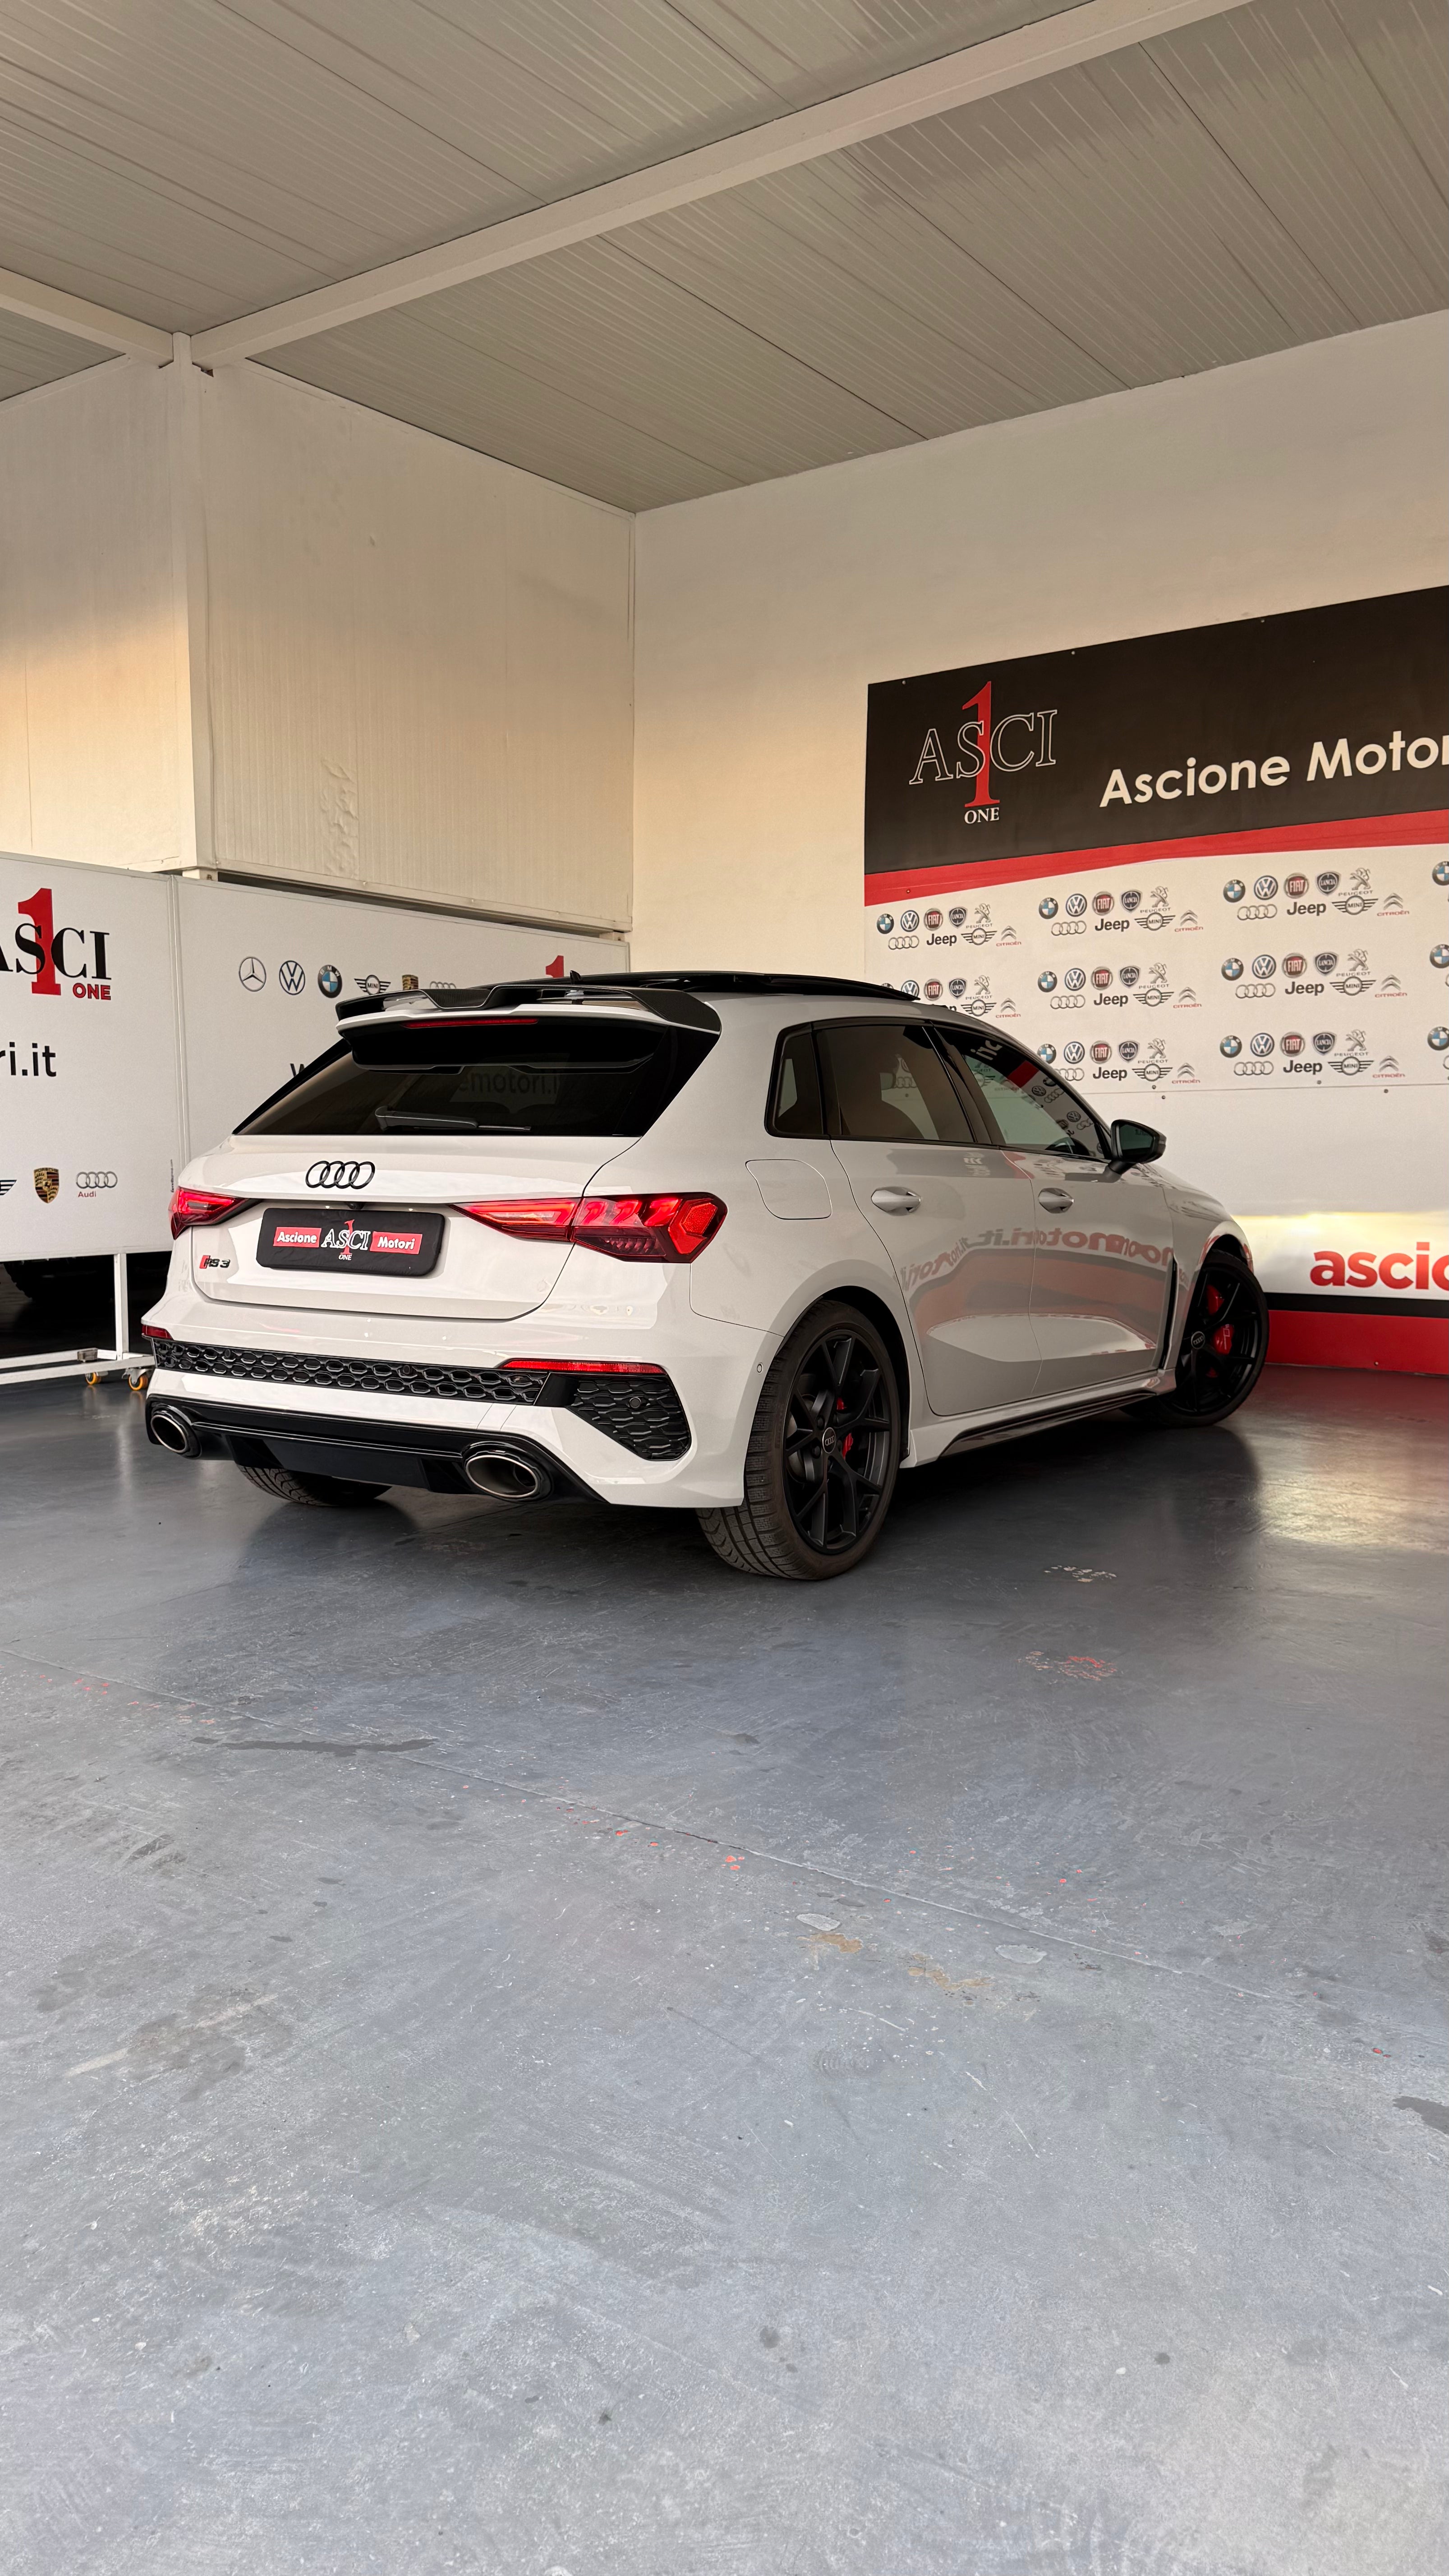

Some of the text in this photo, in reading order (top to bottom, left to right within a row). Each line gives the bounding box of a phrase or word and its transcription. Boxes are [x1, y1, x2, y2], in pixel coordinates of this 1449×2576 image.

[909, 710, 1058, 785] ASCI
[1099, 756, 1290, 808] Ascione
[964, 807, 999, 824] ONE
[1289, 880, 1304, 892] FIAT
[1097, 897, 1110, 909] FIAT
[1287, 902, 1326, 916] Jeep
[928, 915, 939, 925] FIAT
[1095, 918, 1130, 932] Jeep
[926, 934, 957, 946] Jeep
[1288, 960, 1302, 971] FIAT
[1096, 973, 1109, 984] FIAT
[73, 983, 111, 1000] ONE
[929, 985, 940, 995] FIAT
[1285, 981, 1325, 996] Jeep
[1094, 993, 1128, 1007] Jeep
[1286, 1039, 1300, 1050] FIAT
[1095, 1047, 1108, 1058] FIAT
[1093, 1067, 1127, 1081] Jeep
[1283, 1060, 1323, 1075] Jeep
[276, 1231, 317, 1244] Ascione
[321, 1228, 371, 1251] ASCI
[377, 1237, 415, 1250] Motori
